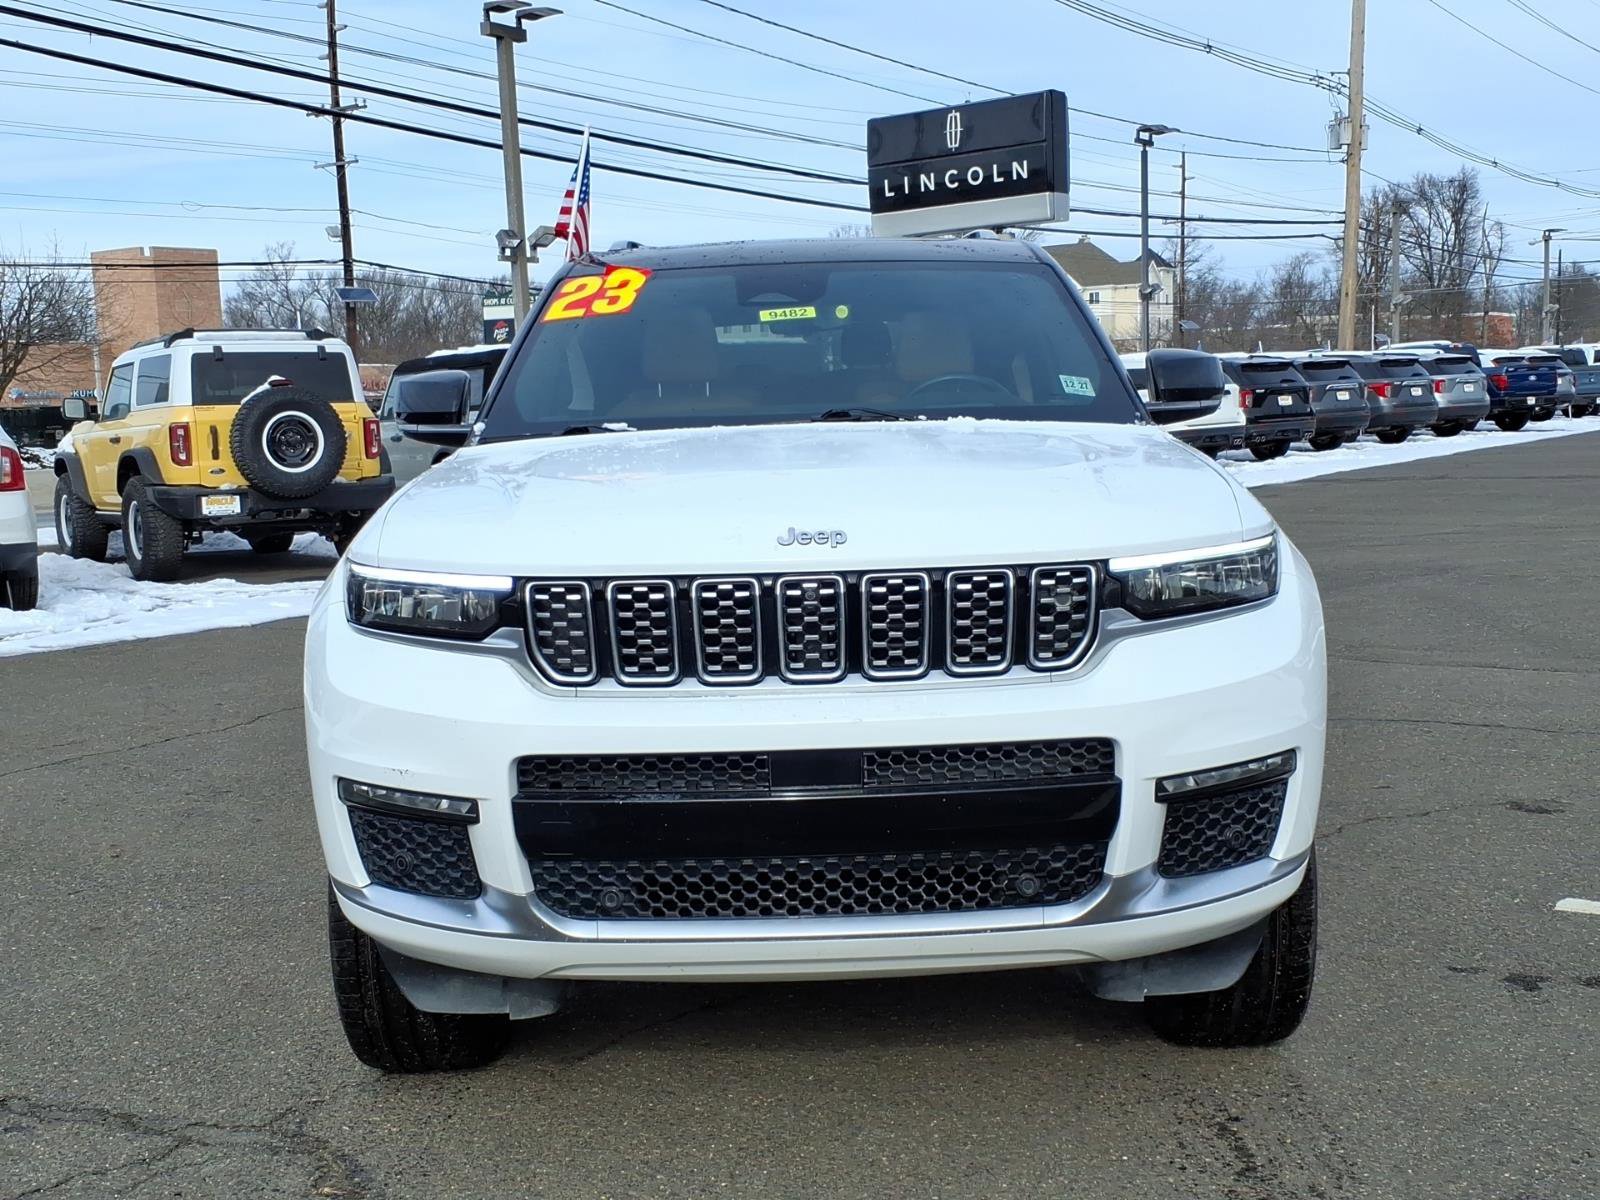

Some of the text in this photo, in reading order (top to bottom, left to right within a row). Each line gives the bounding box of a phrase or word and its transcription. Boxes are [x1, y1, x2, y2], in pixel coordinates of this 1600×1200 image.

[884, 160, 1028, 197] LINCOLN
[543, 268, 646, 321] 23
[768, 308, 808, 319] 9482
[1064, 380, 1076, 388] 12
[73, 389, 98, 397] KUM
[776, 527, 848, 549] Jeep
